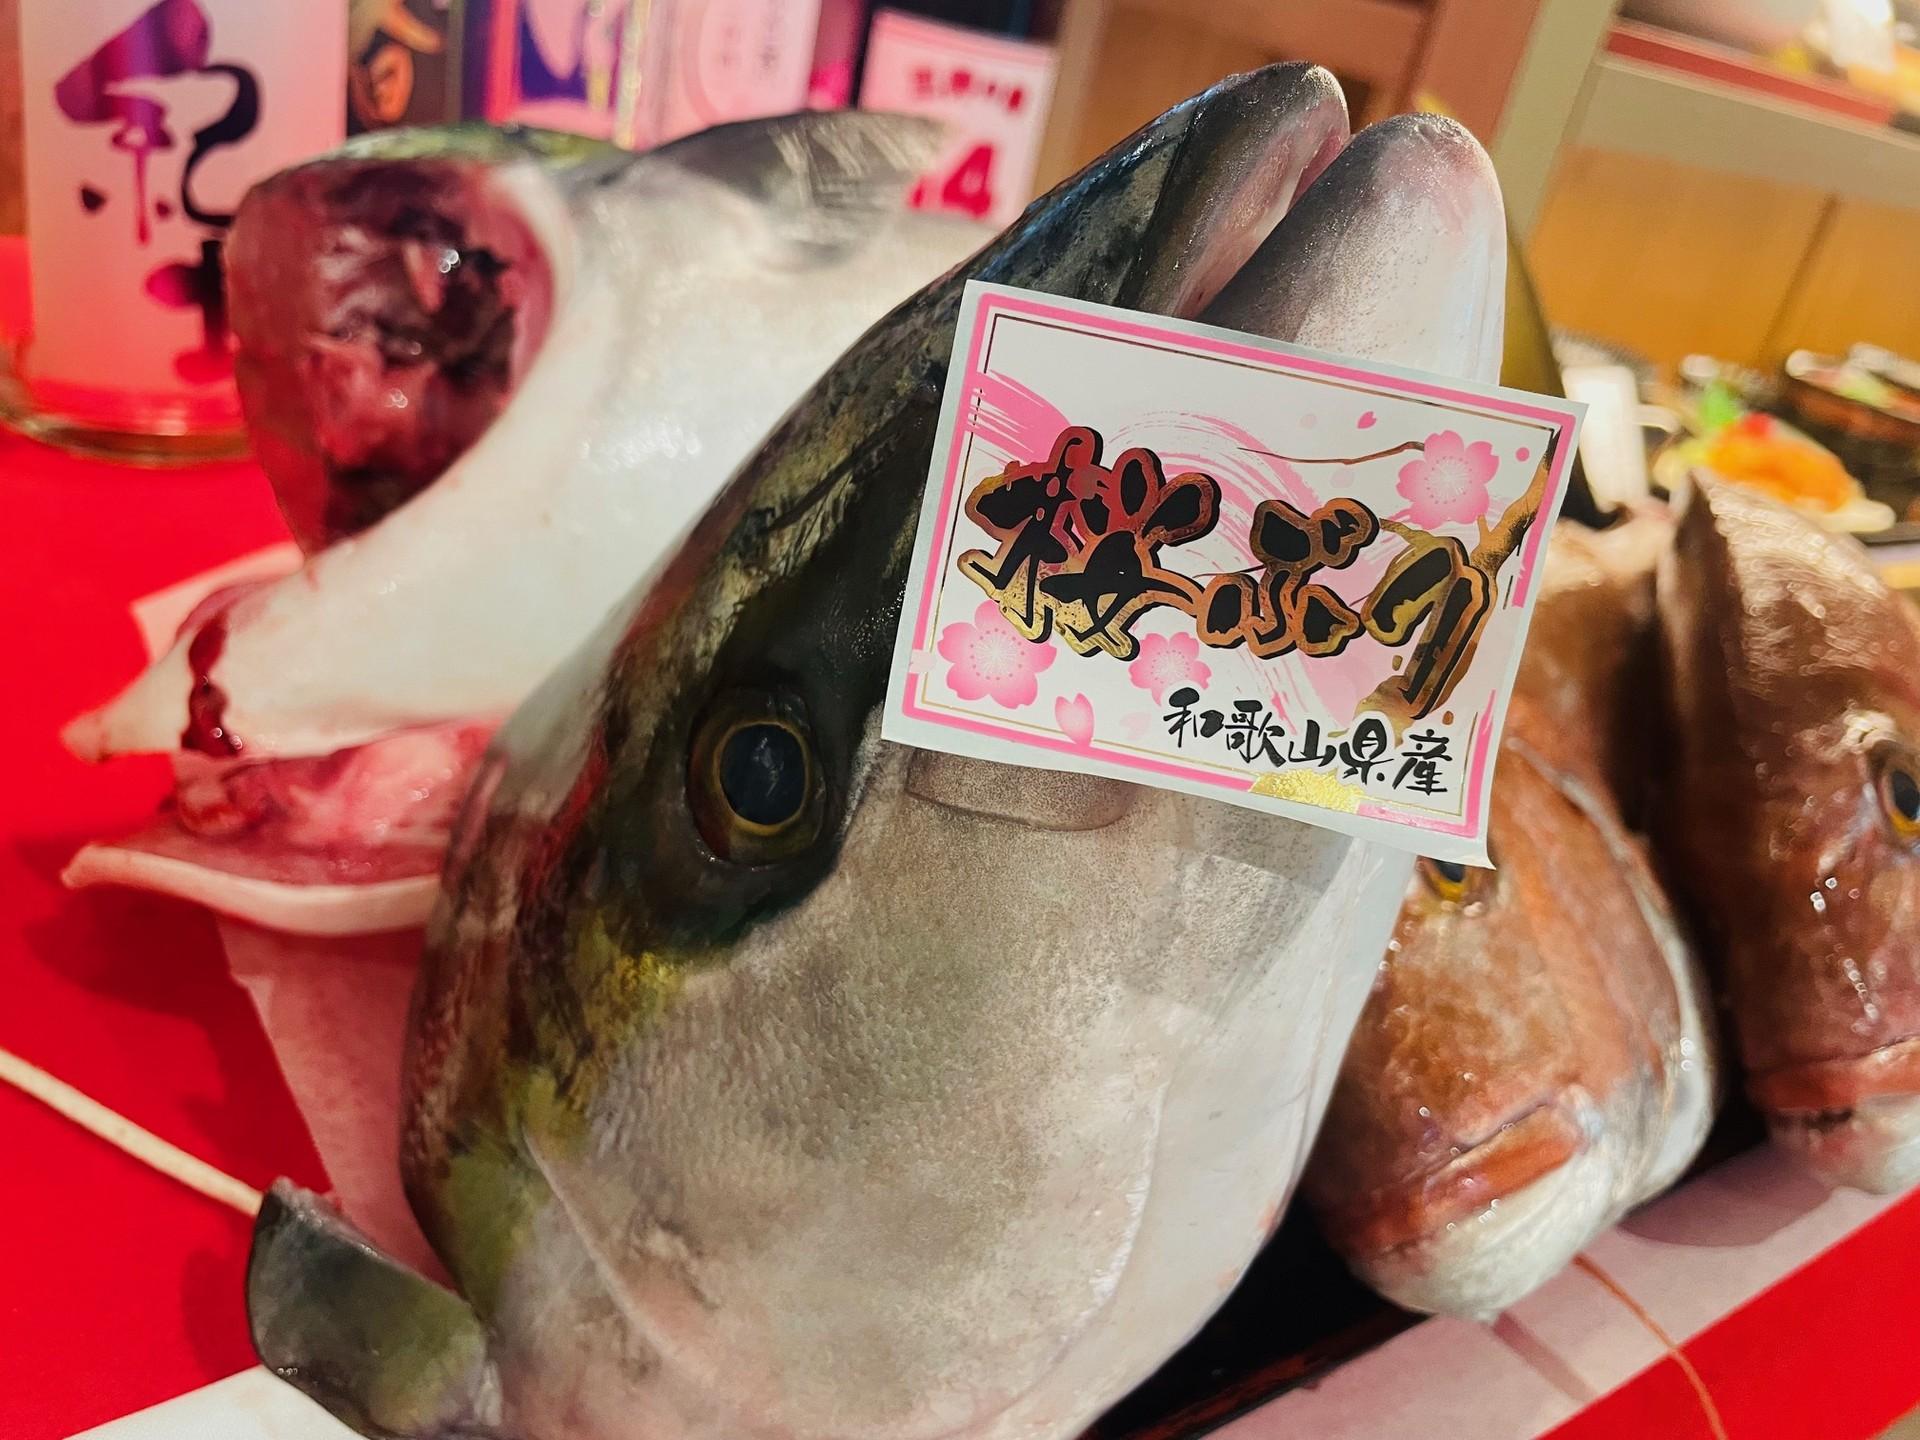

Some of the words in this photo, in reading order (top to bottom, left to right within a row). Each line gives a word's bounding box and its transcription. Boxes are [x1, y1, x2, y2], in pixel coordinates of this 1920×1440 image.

[957, 426, 1492, 719] 桜ぶり
[1163, 686, 1453, 796] 和歌山県産
